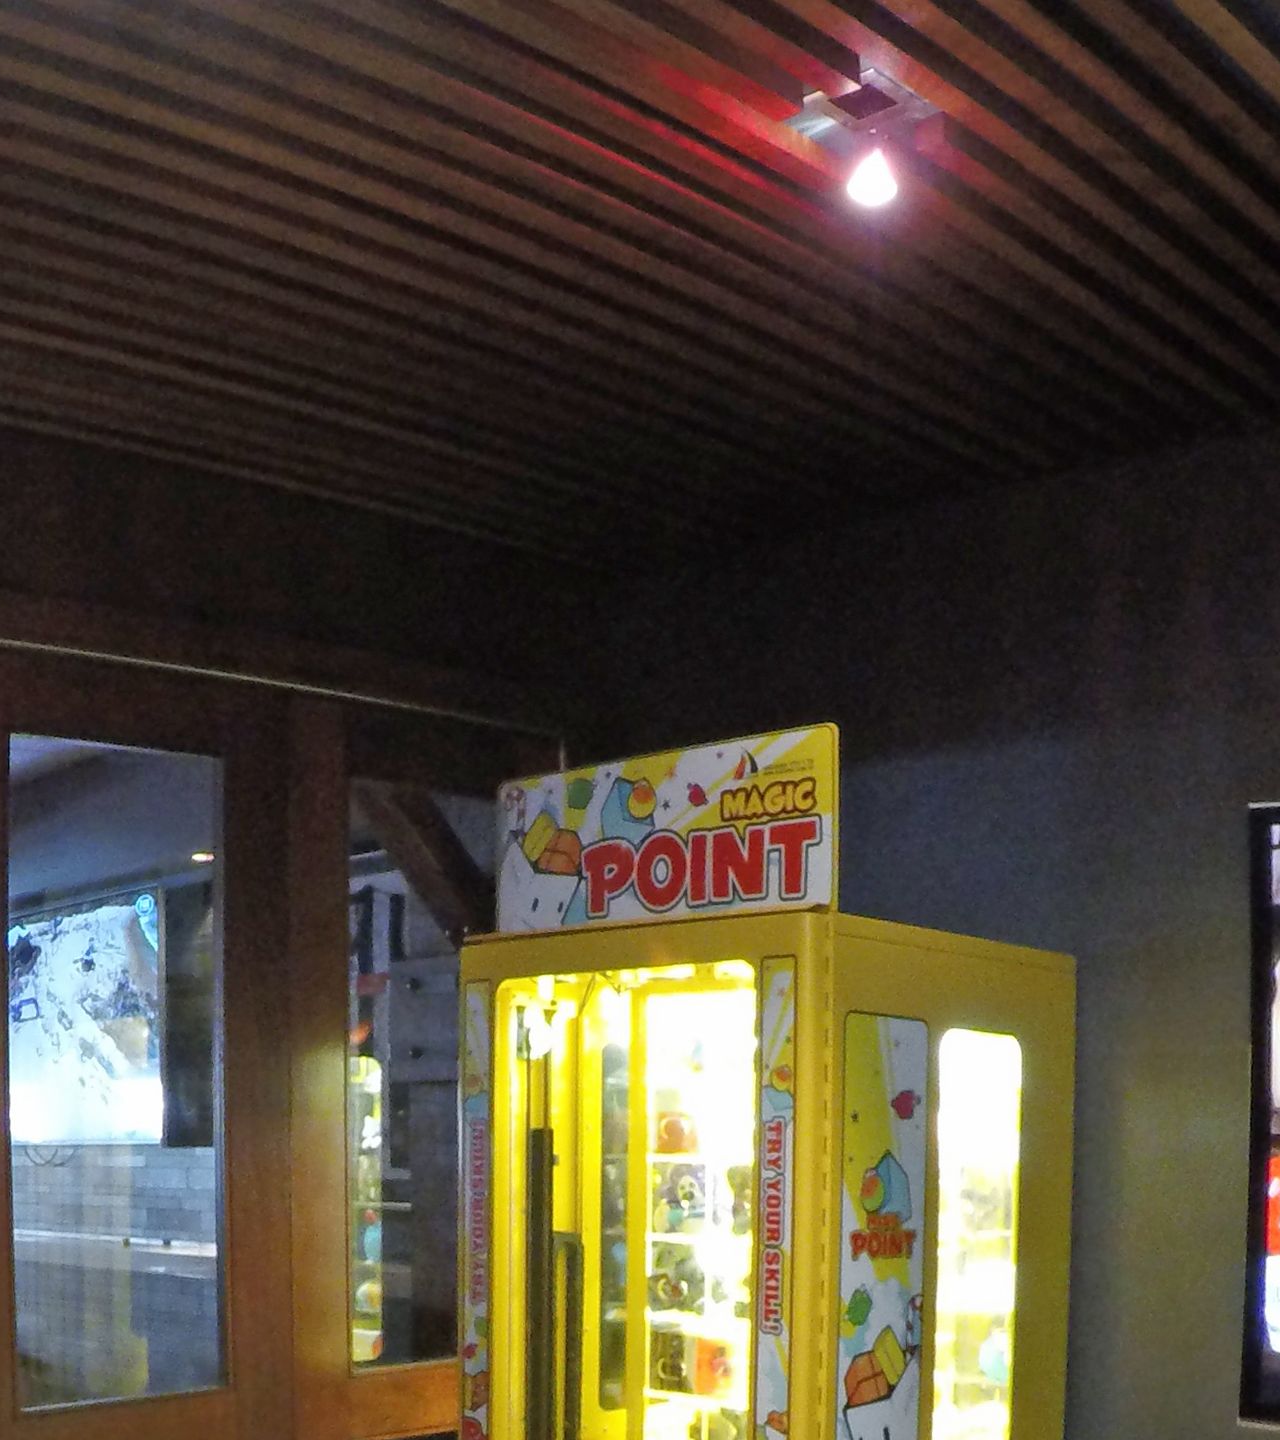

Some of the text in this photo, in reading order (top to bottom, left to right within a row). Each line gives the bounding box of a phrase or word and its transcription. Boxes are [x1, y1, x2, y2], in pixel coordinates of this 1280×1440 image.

[721, 776, 817, 822] MAGIC
[581, 816, 821, 917] POINT
[764, 1120, 785, 1171] TRY
[763, 1174, 784, 1243] YOUR
[850, 1229, 916, 1260] POINT
